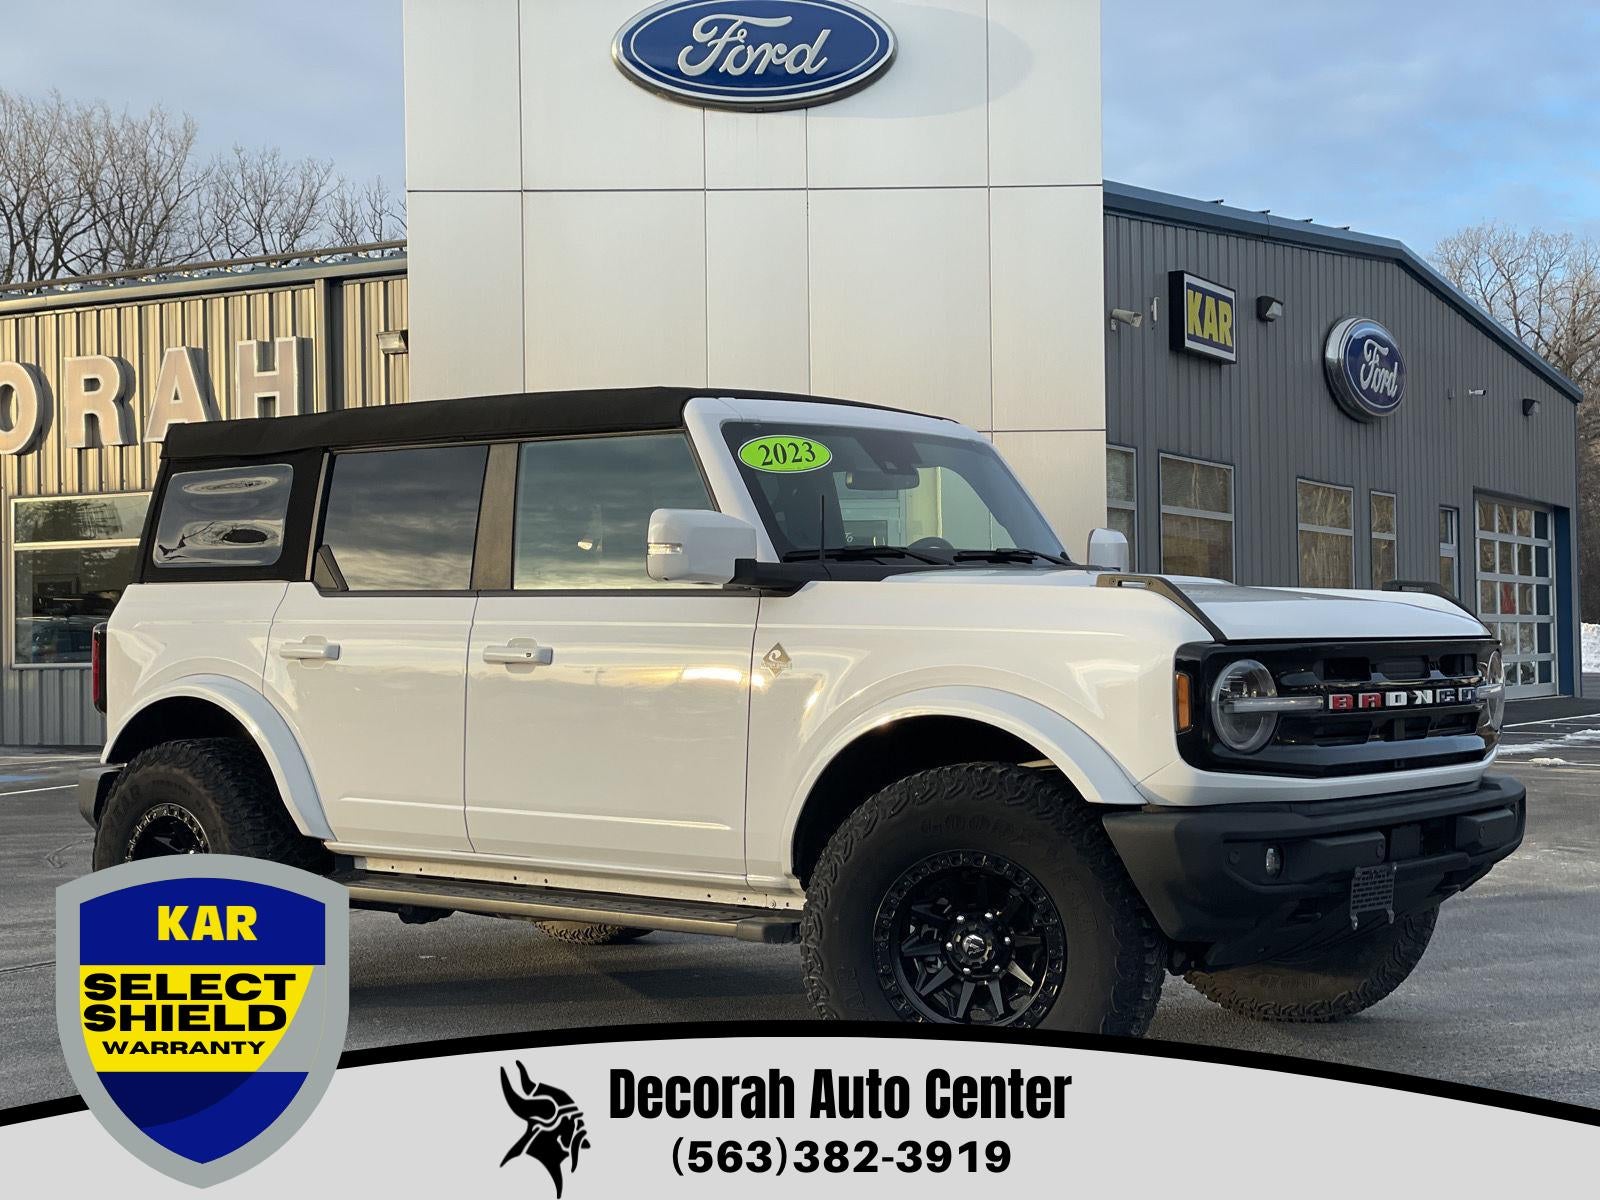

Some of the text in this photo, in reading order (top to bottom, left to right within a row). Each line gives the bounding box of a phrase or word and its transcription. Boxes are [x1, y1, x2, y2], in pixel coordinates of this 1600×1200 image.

[678, 14, 831, 76] Ford
[1187, 289, 1233, 347] KAR
[1360, 338, 1399, 398] Ford
[757, 441, 816, 466] 2023
[1329, 686, 1477, 710] BRONCO
